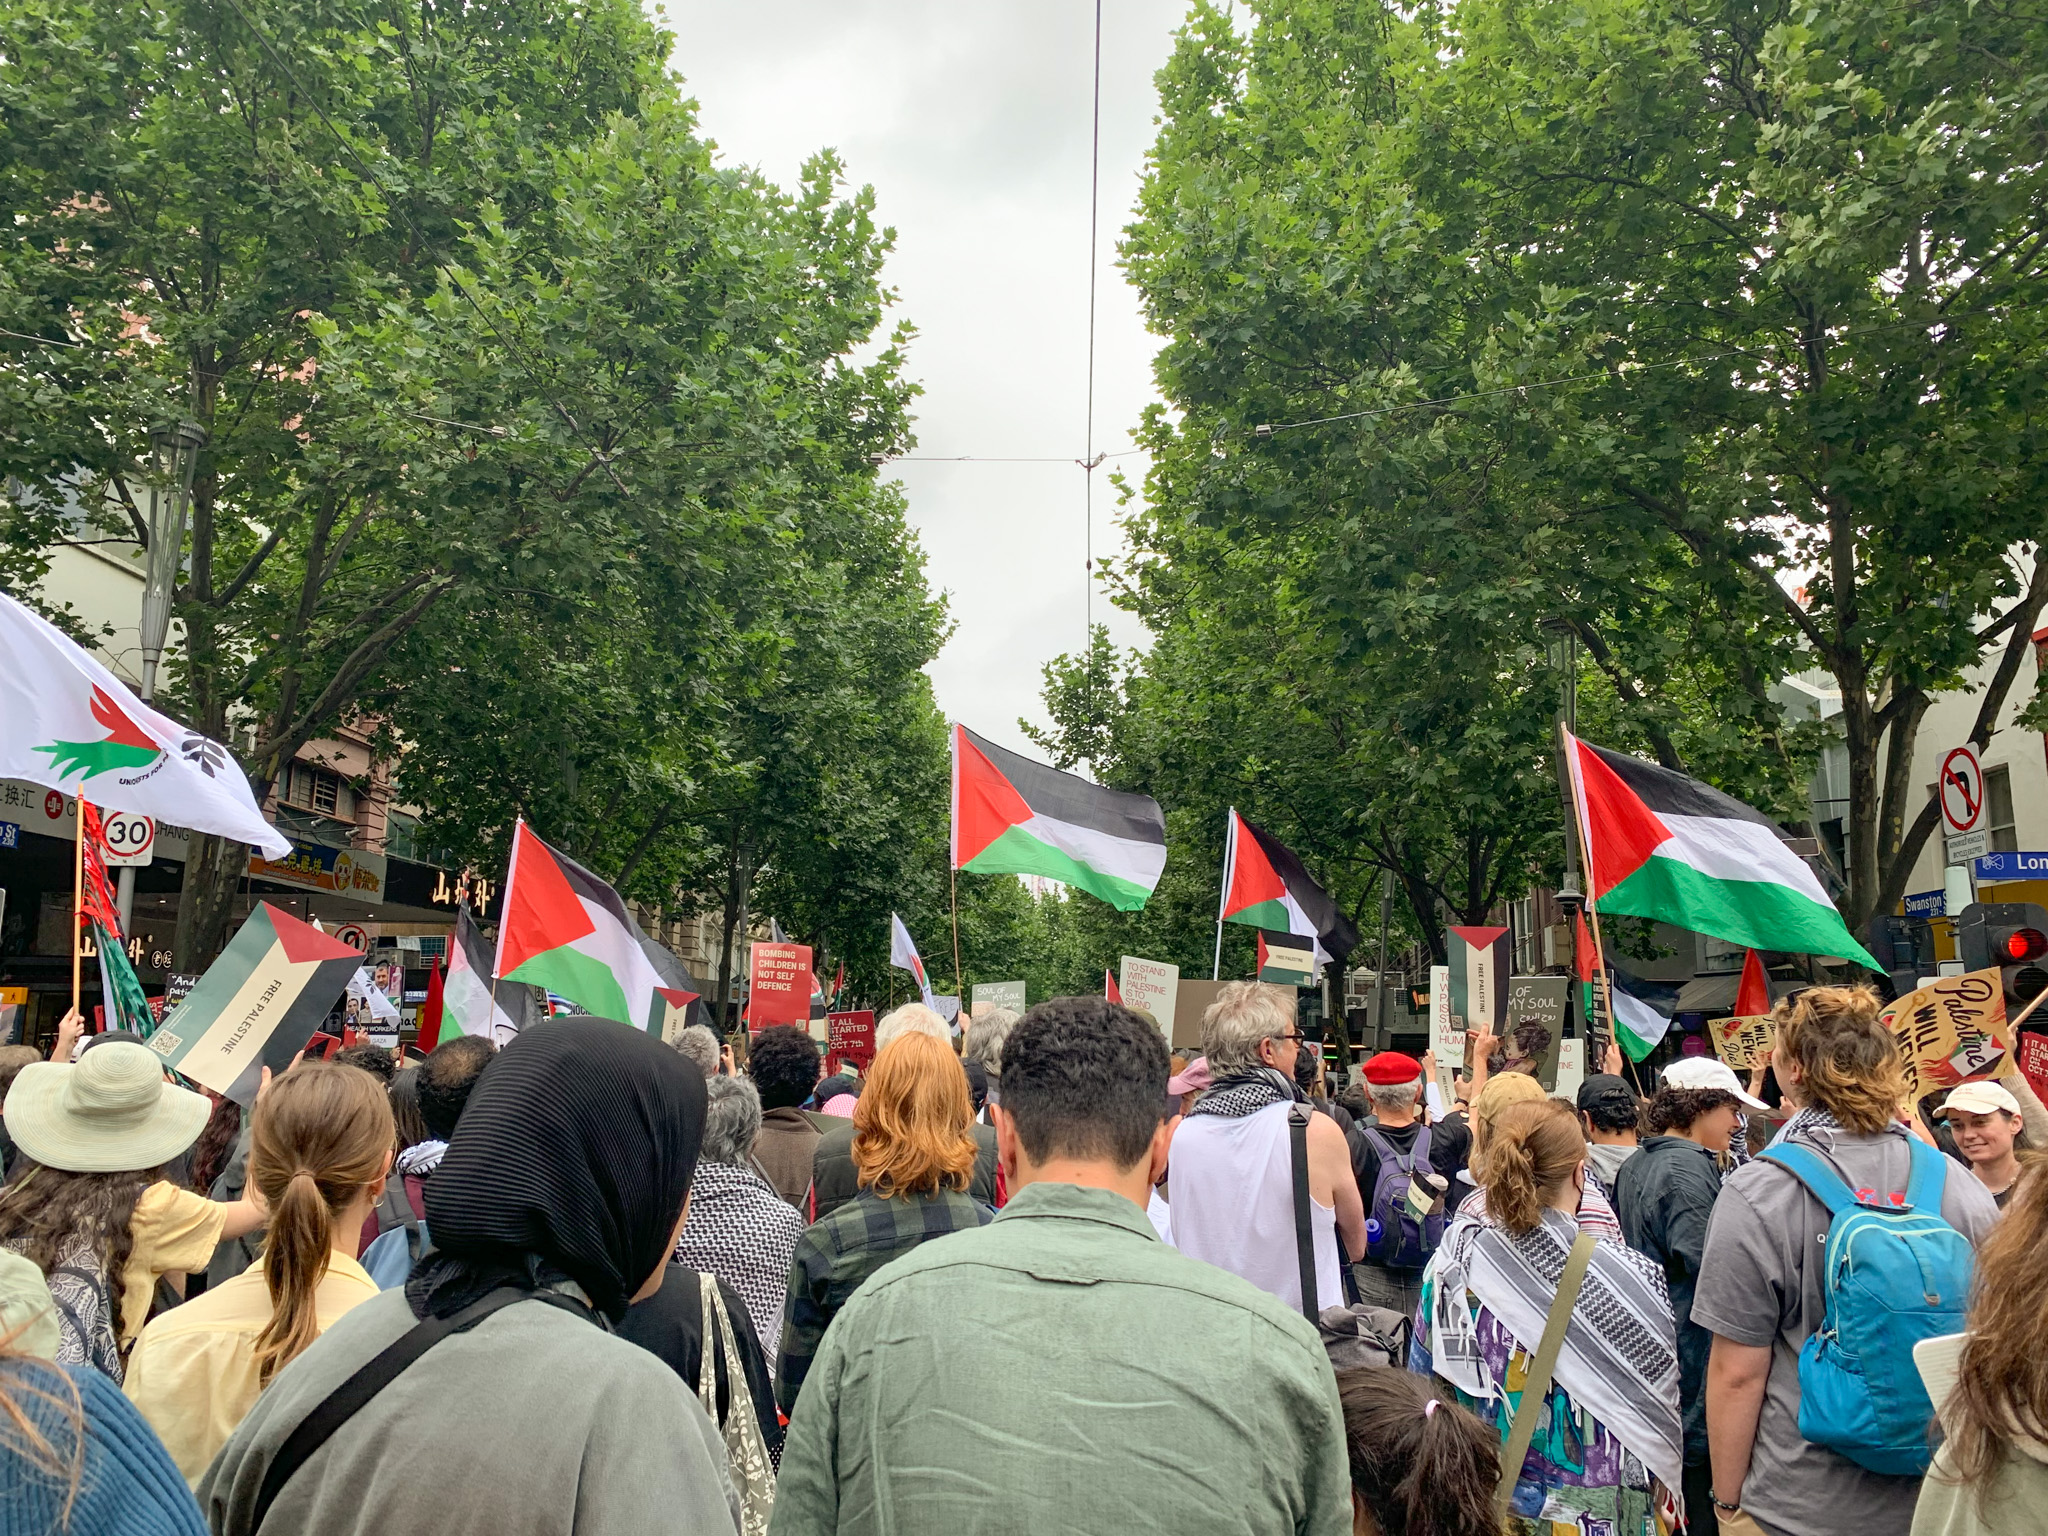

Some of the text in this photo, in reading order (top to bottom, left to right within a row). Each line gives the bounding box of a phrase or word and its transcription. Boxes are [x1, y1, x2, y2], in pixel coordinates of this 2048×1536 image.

[0, 783, 35, 809] 换汇
[5, 824, 16, 839] St
[109, 821, 147, 845] 30
[2, 837, 14, 846] 230
[432, 871, 490, 917] 山外
[1905, 894, 1942, 912] Swanston
[79, 936, 145, 966] 山外
[759, 949, 796, 959] BOMBING
[758, 960, 806, 971] CHILDREN IS
[1127, 962, 1166, 977] TO STAND
[758, 970, 795, 980] NOT SELF
[1127, 971, 1147, 982] WITH
[757, 981, 792, 991] DEFENCE
[977, 986, 1006, 996] SOUL OF
[1126, 980, 1167, 996] PALESTINE
[1515, 986, 1532, 997] OF
[992, 992, 1021, 1002] MY SOUL
[1125, 988, 1145, 999] IS TO
[1125, 997, 1151, 1009] STAND
[1508, 997, 1558, 1010] MY SOUL
[220, 979, 282, 1054] FREE PALESTINE
[838, 1018, 854, 1026] ALL
[1913, 1003, 1941, 1053] WILL
[1934, 978, 1993, 1068] Palestine
[1754, 1024, 1768, 1047] WILL
[830, 1040, 864, 1049] OCT 7th
[2031, 1039, 2039, 1048] IT
[1722, 1043, 1745, 1067] Die!
[2029, 1056, 2041, 1066] ON
[2028, 1064, 2043, 1075] OCT
